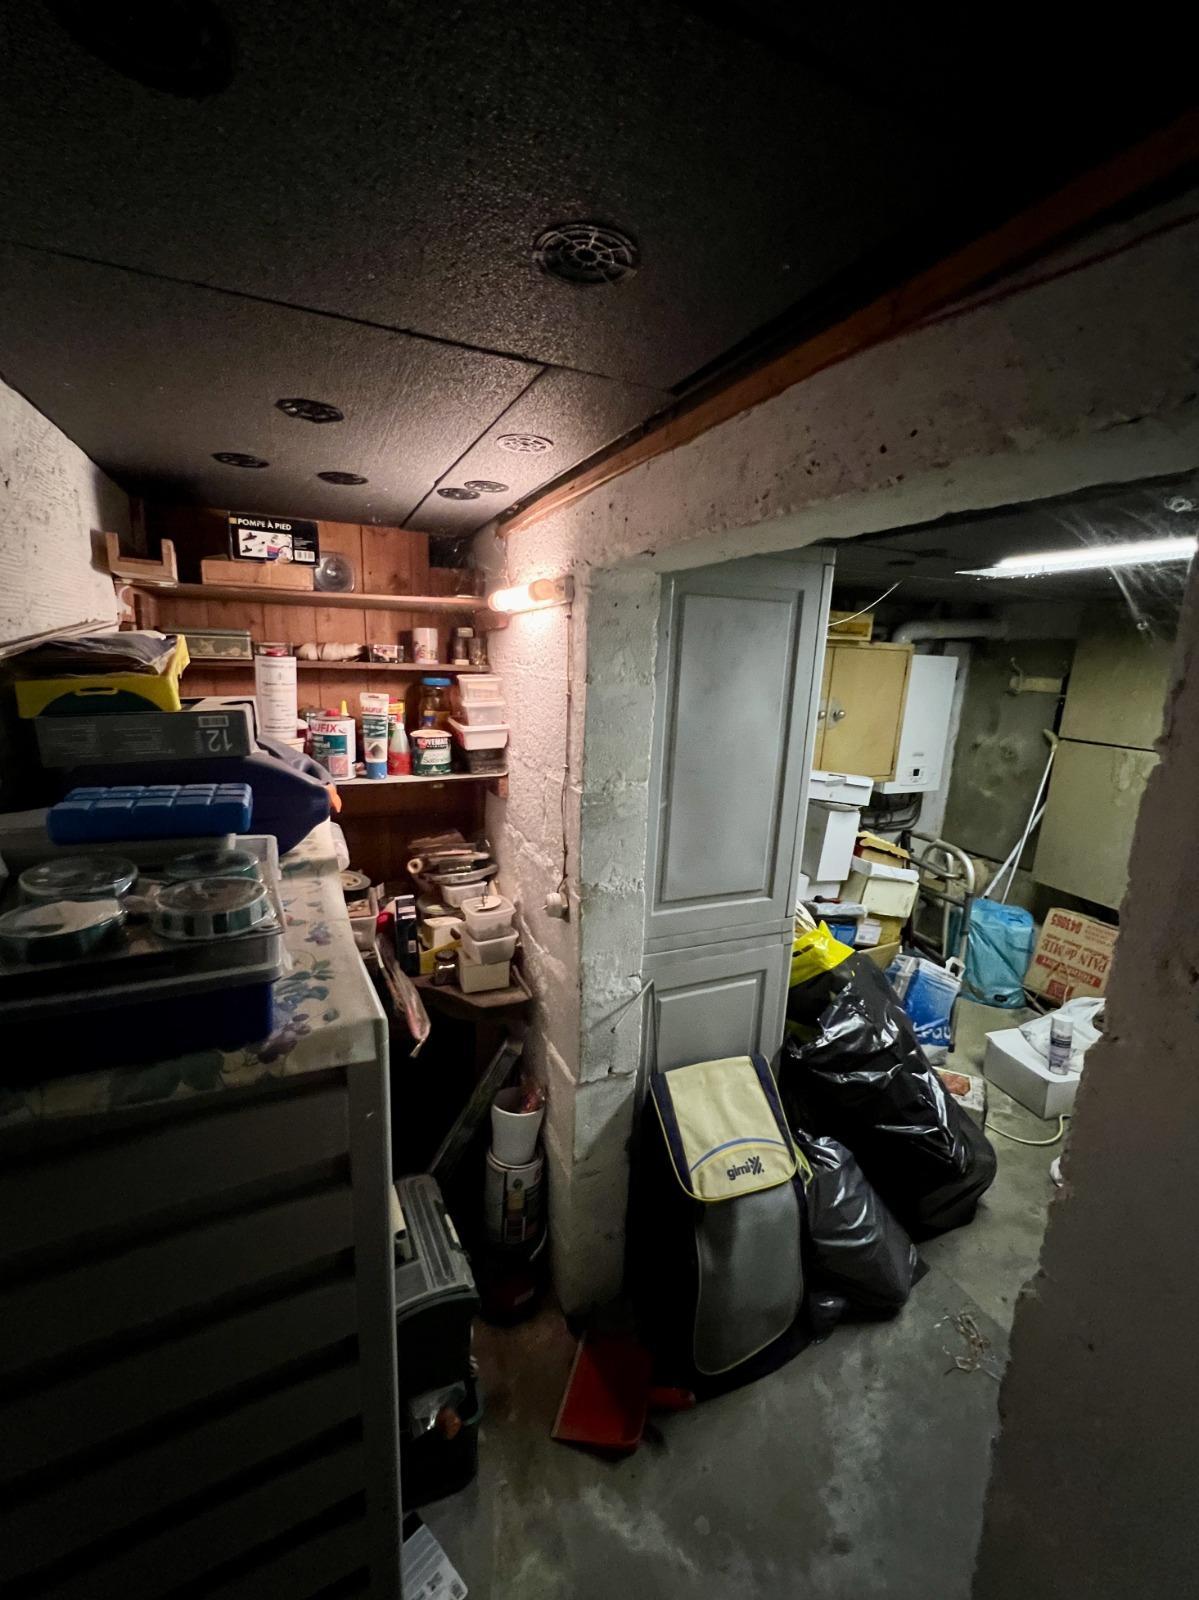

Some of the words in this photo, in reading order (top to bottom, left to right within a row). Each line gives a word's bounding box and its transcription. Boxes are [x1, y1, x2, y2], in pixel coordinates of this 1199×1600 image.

[237, 518, 265, 528] POMPE
[267, 520, 273, 528] À
[275, 522, 292, 531] PIED
[206, 730, 233, 752] 12
[1041, 939, 1064, 957] MIE
[1079, 952, 1108, 973] PAIN
